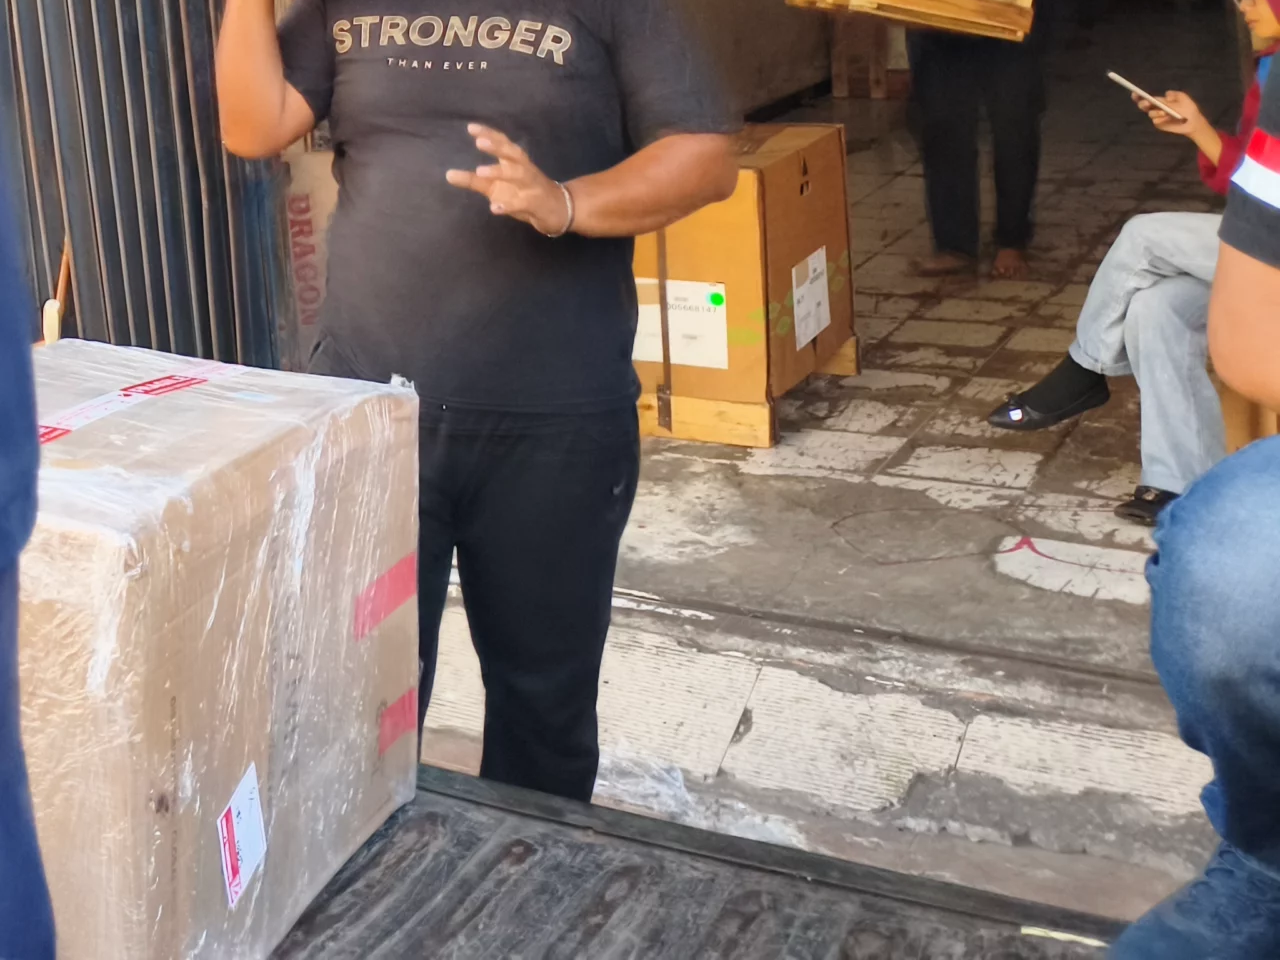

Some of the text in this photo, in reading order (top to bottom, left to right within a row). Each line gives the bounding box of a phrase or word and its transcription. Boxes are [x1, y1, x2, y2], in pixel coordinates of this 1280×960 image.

[332, 15, 572, 65] STRONGER
[387, 57, 488, 71] THAN EVER
[288, 193, 321, 327] DRAGON
